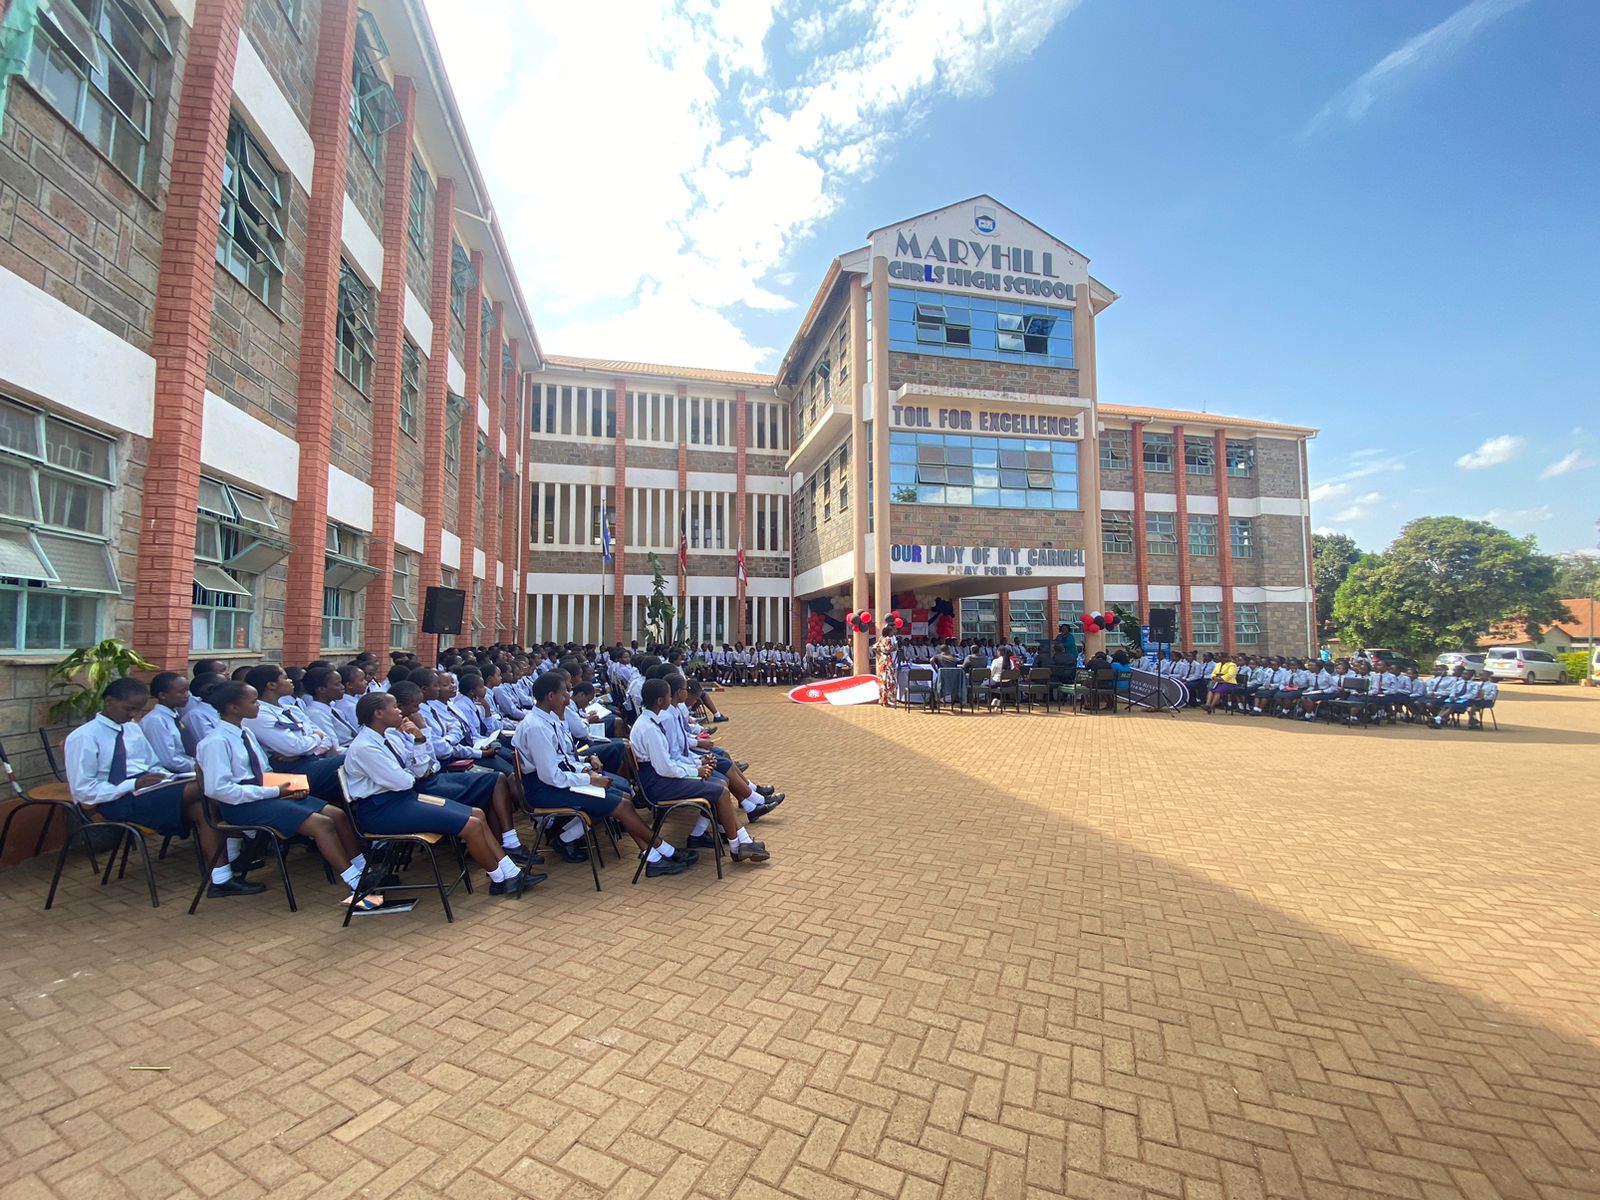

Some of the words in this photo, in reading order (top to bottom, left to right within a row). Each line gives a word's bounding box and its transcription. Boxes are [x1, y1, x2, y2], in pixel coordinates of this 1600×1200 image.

[895, 231, 1060, 279] MARYHILL
[888, 261, 945, 284] GIRLS
[947, 268, 1001, 292] HIGH
[1003, 275, 1077, 302] SCHOOL
[892, 405, 931, 428] TOIL
[939, 409, 972, 431] FOR
[979, 411, 1079, 437] EXCELLENCE
[891, 544, 922, 563] OUR
[926, 544, 965, 565] LADY
[971, 547, 990, 565] OF
[998, 547, 1022, 566] MT
[1027, 549, 1085, 567] CARMEL
[947, 565, 979, 576] PRAY
[984, 566, 1007, 576] FOR
[1015, 566, 1033, 576] US
